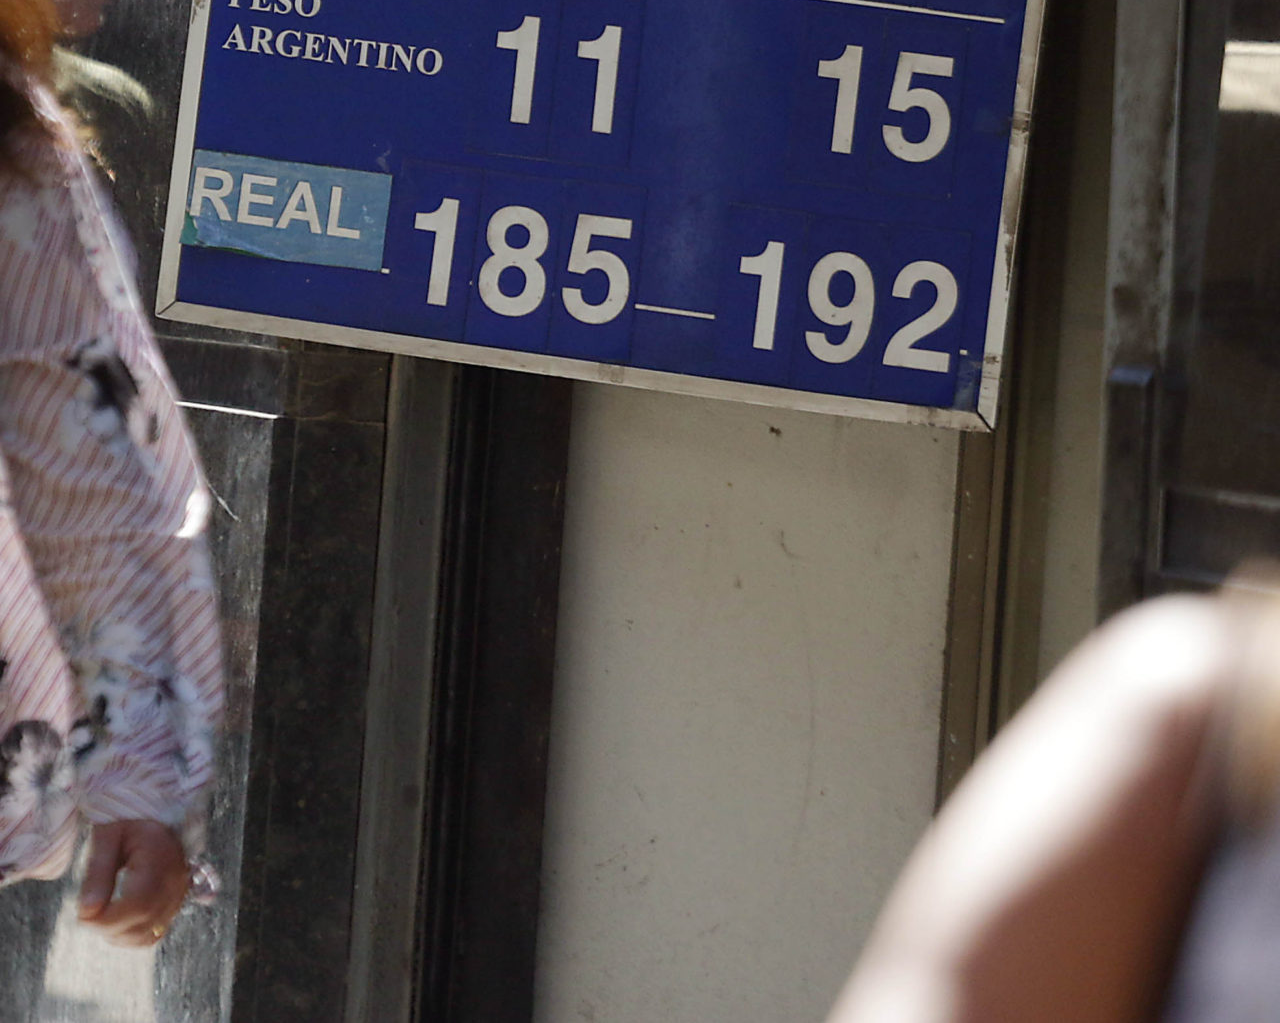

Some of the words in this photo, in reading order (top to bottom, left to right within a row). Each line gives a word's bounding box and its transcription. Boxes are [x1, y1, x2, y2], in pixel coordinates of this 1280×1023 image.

[223, 24, 442, 74] ARGENTINO
[497, 16, 621, 133] 11
[818, 45, 953, 162] 15
[189, 166, 361, 239] REAL
[415, 198, 632, 324] 185
[740, 242, 957, 372] 192
